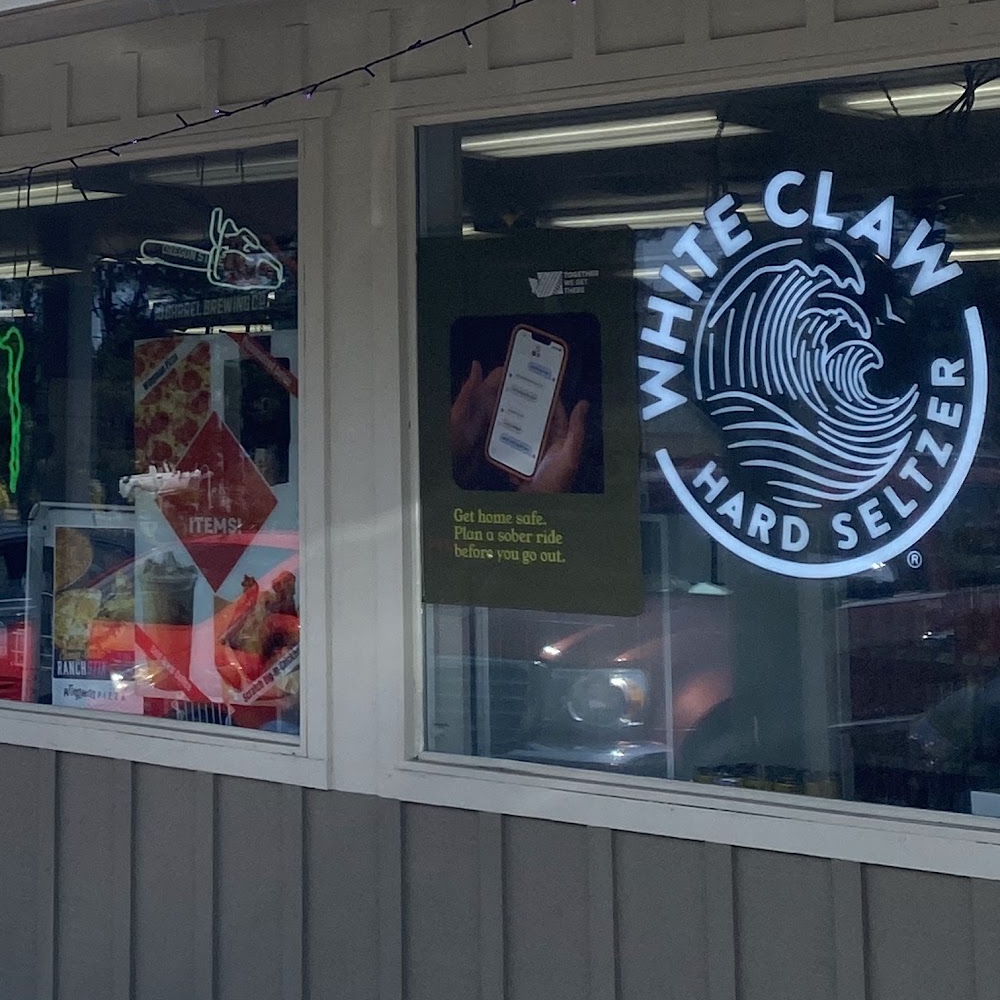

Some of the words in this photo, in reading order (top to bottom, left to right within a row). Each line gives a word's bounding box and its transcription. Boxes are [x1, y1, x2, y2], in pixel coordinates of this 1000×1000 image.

[638, 194, 752, 421] WHITE
[764, 170, 963, 296] CLAW
[692, 461, 811, 551] HARD
[831, 357, 966, 550] SELTZER
[453, 508, 475, 523] Get
[478, 509, 513, 525] home
[516, 510, 547, 526] safe.
[454, 525, 483, 541] Plan
[486, 531, 495, 541] a
[498, 528, 533, 543] sober
[536, 529, 564, 545] ride
[453, 543, 494, 559] before
[497, 548, 520, 563] you
[522, 549, 537, 565] go
[540, 549, 567, 563] out.
